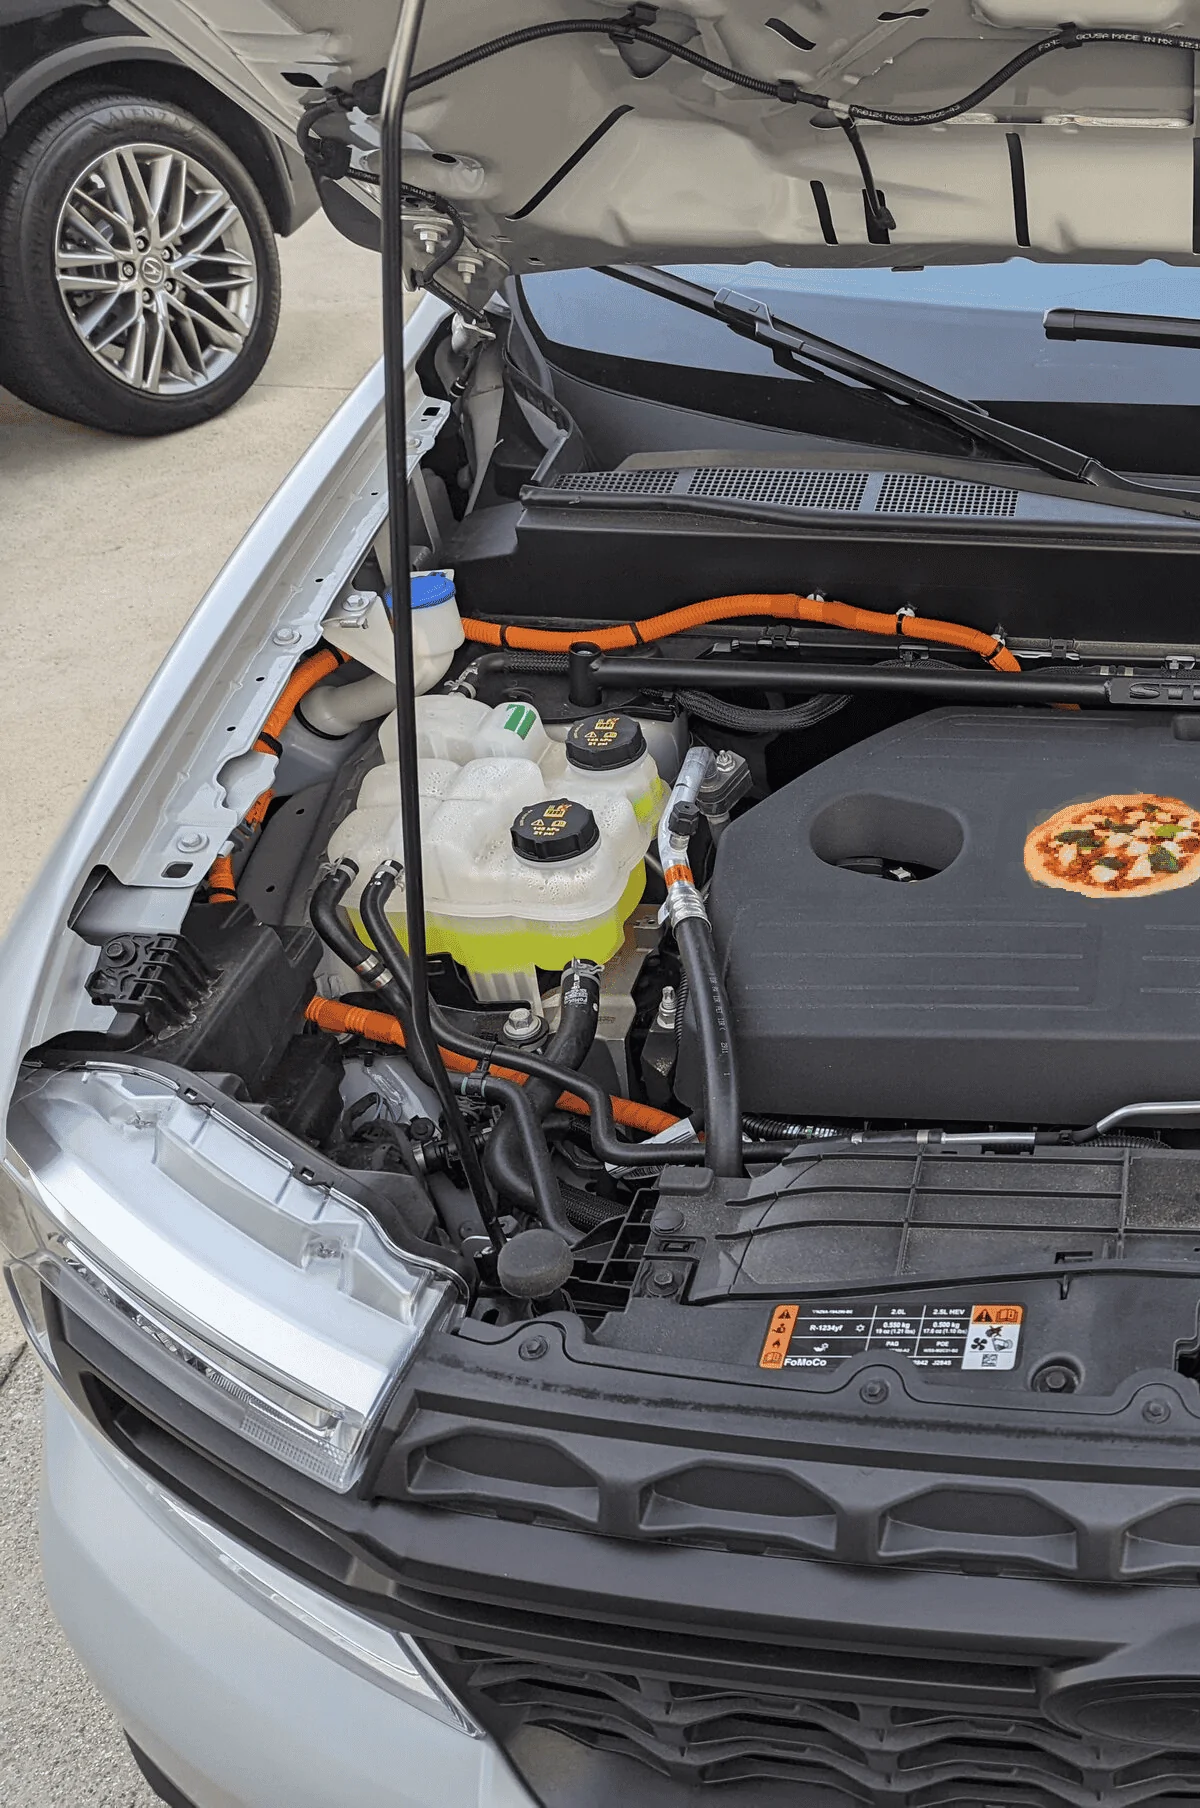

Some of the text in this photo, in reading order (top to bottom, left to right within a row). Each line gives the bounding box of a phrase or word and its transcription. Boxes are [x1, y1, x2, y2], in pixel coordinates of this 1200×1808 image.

[1111, 33, 1140, 41] MADE
[1143, 35, 1155, 43] IN
[809, 1324, 843, 1332] R-1234yf
[900, 1321, 911, 1329] kg
[950, 1321, 961, 1329] kg
[783, 1358, 827, 1367] FoMoCo
